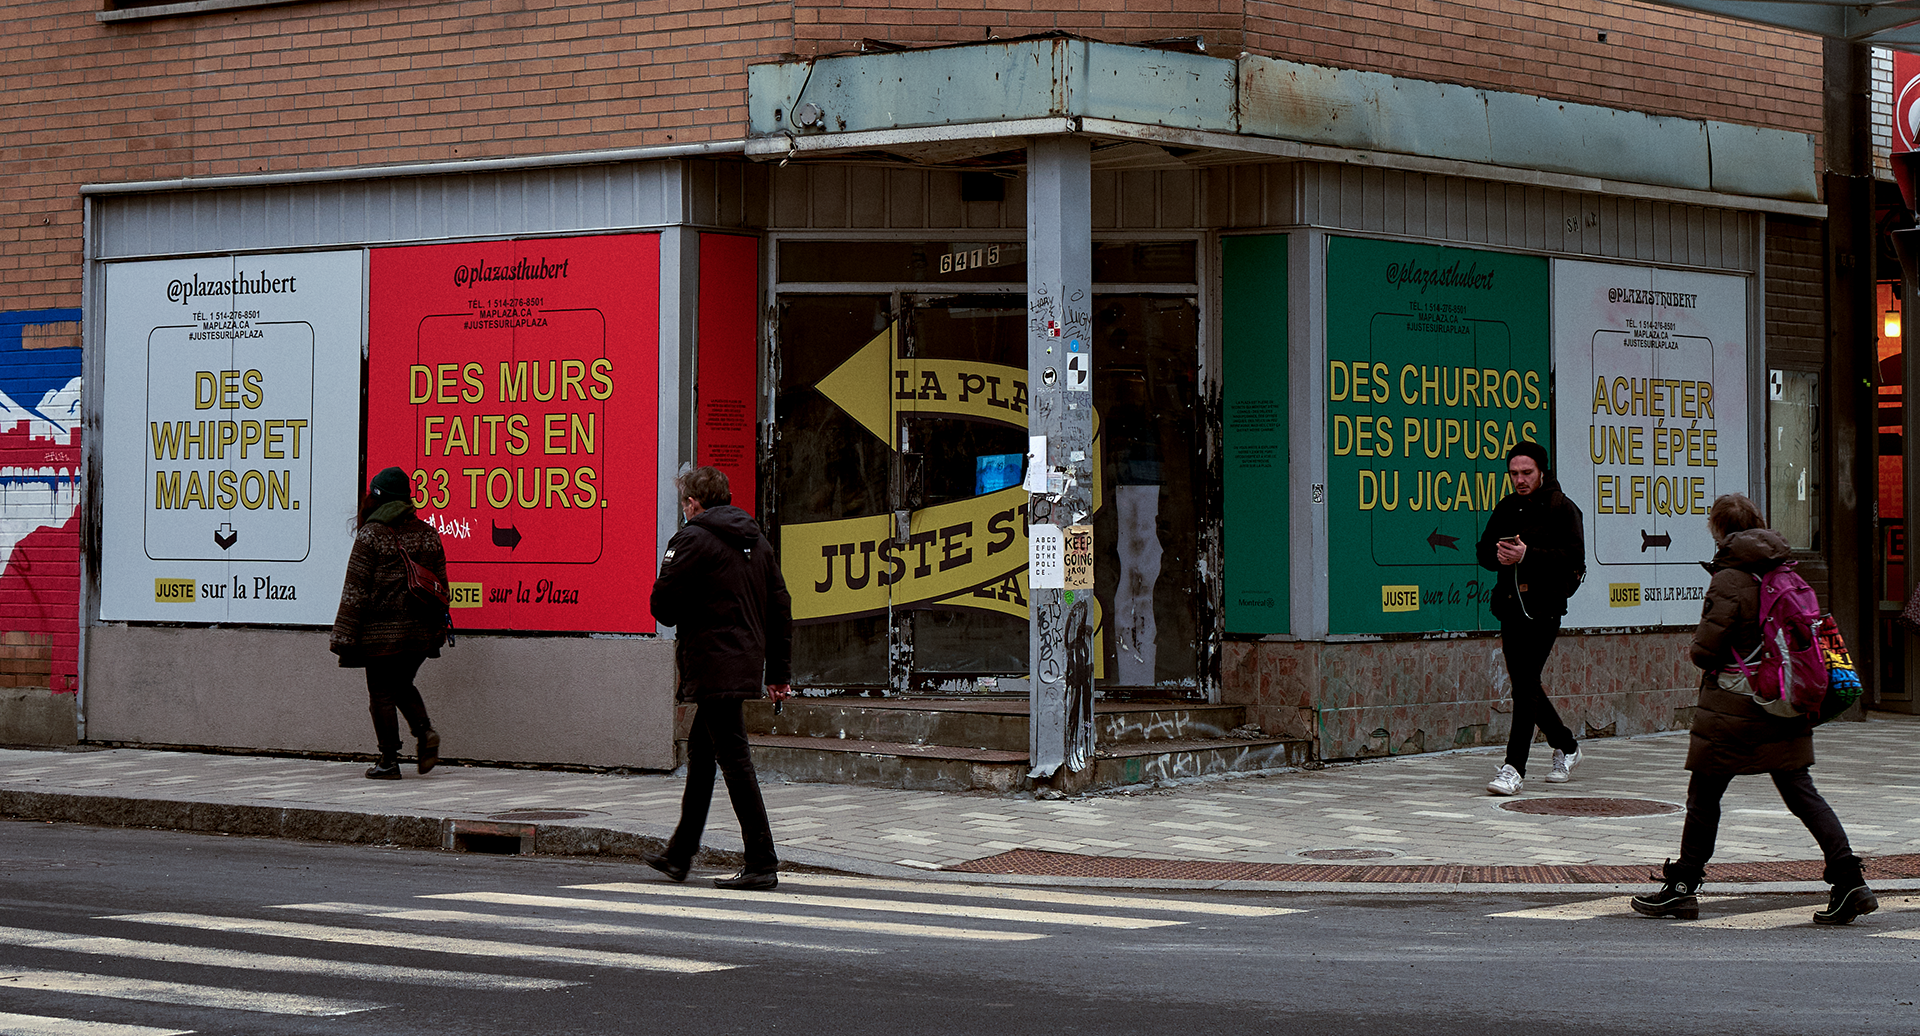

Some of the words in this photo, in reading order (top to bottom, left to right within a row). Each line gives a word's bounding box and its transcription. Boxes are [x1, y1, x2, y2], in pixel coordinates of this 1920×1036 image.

[454, 257, 569, 289] @plazasthubert
[941, 246, 998, 272] 6415
[167, 269, 297, 305] @plazasthubert
[1386, 259, 1494, 294] @plazasthubert
[193, 311, 208, 321] TÉL.
[210, 312, 214, 320] 1
[216, 310, 260, 320] 514-276-8501
[468, 298, 485, 309] TÉL.
[488, 300, 491, 308] 1
[494, 297, 544, 308] 514-276-8501
[480, 308, 532, 318] MAPLAZA.CA
[1409, 300, 1423, 311] TÉL.
[1429, 303, 1467, 314] 514-276-8501
[203, 320, 250, 330] MAPLAZA.CA
[464, 318, 548, 330] #JUSTESURLAPLAZA
[1407, 322, 1470, 334] #JUSTESURLAPLAZA
[1419, 313, 1459, 324] MAPLAZA.CA
[1626, 318, 1638, 328] TÉL.
[188, 330, 264, 340] #JUSTESURLAPLAZA
[1623, 338, 1679, 350] #JUSTESURLAPLAZA
[1634, 329, 1669, 339] MAPLAZA.CA
[194, 368, 264, 410] DES
[409, 362, 484, 405] DES
[499, 358, 615, 402] MURS
[895, 370, 947, 401] LA
[1329, 360, 1390, 404] DES
[1399, 363, 1548, 411] CHURROS.
[1592, 376, 1714, 419] ACHETER
[150, 419, 308, 460] WHIPPET
[424, 414, 530, 456] FAITS
[544, 413, 595, 455] EN
[1333, 414, 1394, 458] DES
[1590, 425, 1644, 465] UNE
[1654, 418, 1718, 467] ÉPÉE
[155, 469, 300, 510] MAISON.
[410, 468, 451, 509] 33
[463, 466, 608, 509] TOURS.
[1358, 469, 1400, 512] DU
[1598, 475, 1711, 518] ELFIQUE.
[815, 521, 972, 593] JUSTE
[1065, 536, 1092, 551] KEEP
[1064, 553, 1093, 566] GOING
[156, 584, 194, 598] JUSTE
[201, 583, 227, 599] sur
[232, 574, 247, 599] la
[253, 575, 297, 600] Plaza
[450, 588, 480, 603] USTE
[489, 588, 513, 603] sur
[516, 581, 530, 603] la
[535, 579, 579, 604] Plaza
[1383, 591, 1417, 606] JUSTE
[1423, 590, 1445, 605] sur
[1448, 582, 1461, 604] la
[1466, 580, 1493, 612] Pla
[1610, 588, 1639, 602] JUSTE
[1644, 587, 1662, 601] SUR
[1664, 587, 1674, 600] LA
[1676, 587, 1705, 600] PLAZA
